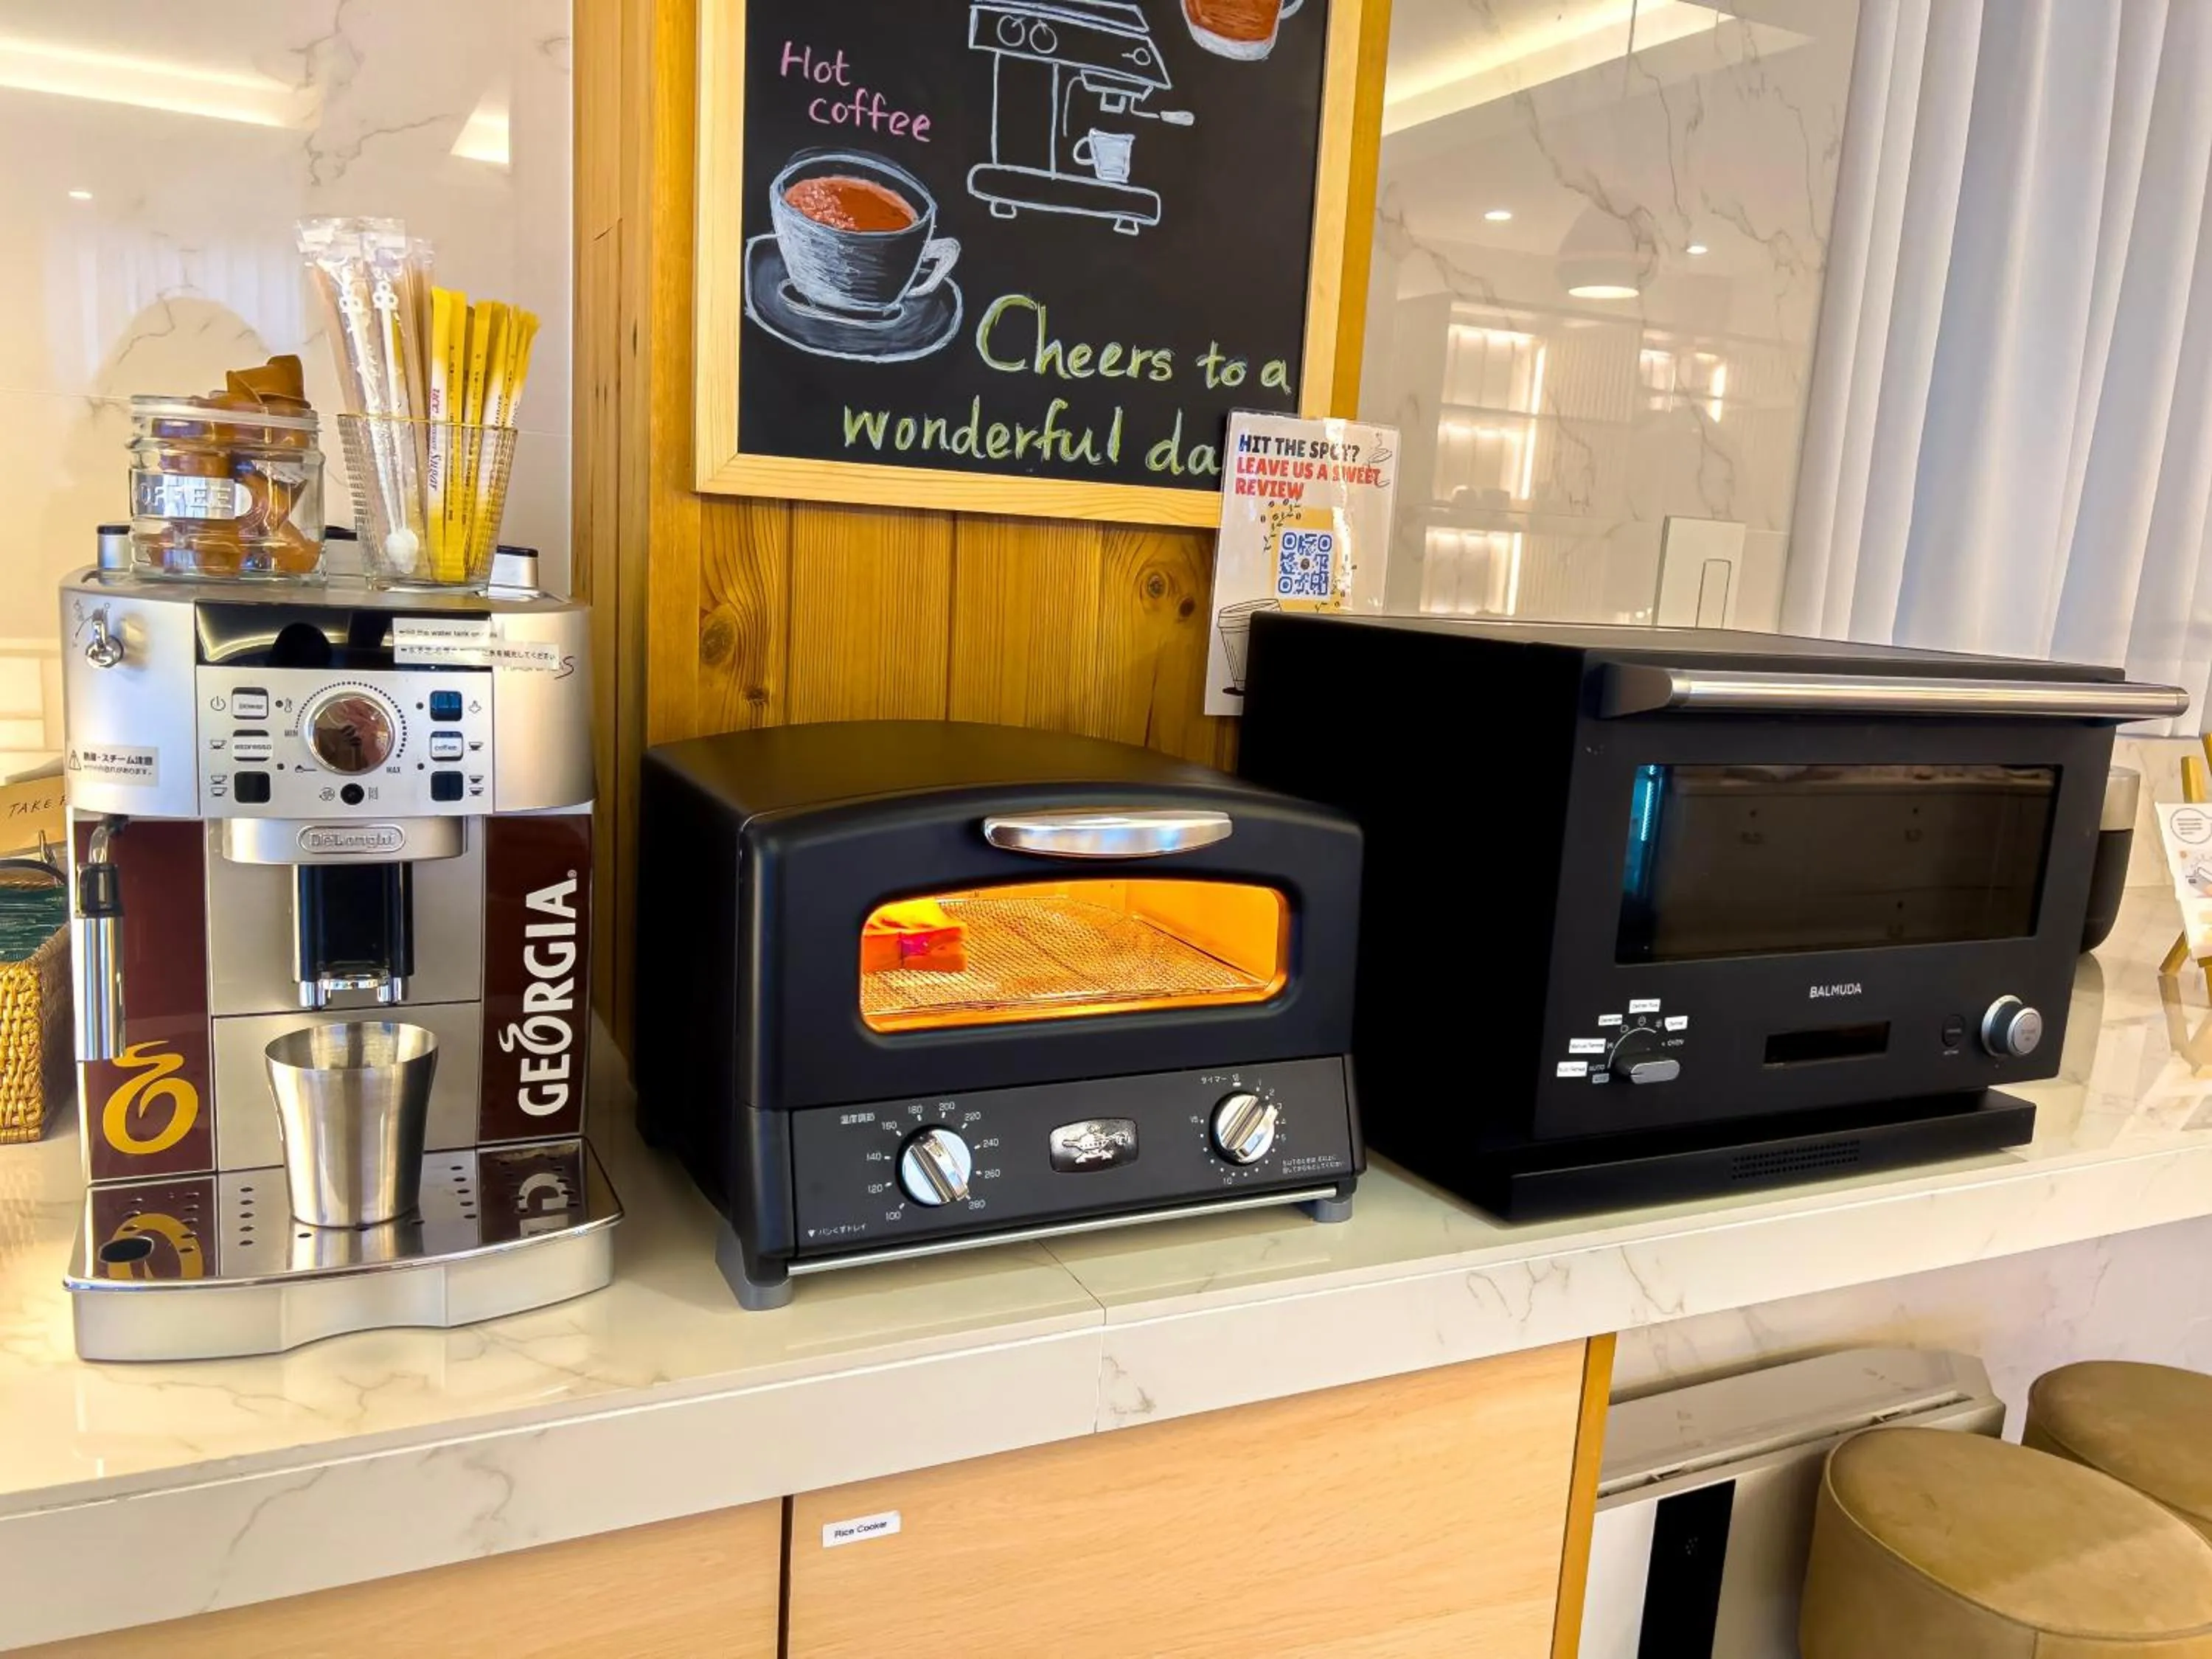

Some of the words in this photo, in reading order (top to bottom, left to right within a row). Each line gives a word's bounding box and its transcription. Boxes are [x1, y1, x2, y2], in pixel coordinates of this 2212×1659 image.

[780, 41, 851, 87] Hot
[808, 88, 933, 143] coffee
[975, 294, 1174, 381] Cheers
[1197, 341, 1248, 390] to
[1259, 358, 1293, 395] a
[842, 394, 1124, 466] wonderful
[1145, 408, 1222, 477] da
[1238, 434, 1271, 454] HIT
[1275, 438, 1306, 458] THE
[429, 454, 442, 491] Sugar
[1237, 456, 1289, 478] LEAVE
[1293, 462, 1313, 481] US
[1317, 464, 1327, 481] A
[1332, 467, 1381, 486] SWEET
[1235, 478, 1304, 500] REVIEW
[386, 766, 401, 774] MAX
[8, 799, 52, 818] TAKE
[498, 878, 578, 1117] GEORGIA
[1809, 982, 1862, 999] BALMUDA
[1200, 1075, 1228, 1085] タイマー
[908, 1105, 922, 1115] 180
[938, 1101, 956, 1111] 200
[964, 1110, 981, 1121] 220
[983, 1138, 1000, 1148] 240
[866, 1152, 882, 1162] 140
[984, 1169, 1001, 1179] 260
[1223, 1177, 1233, 1186] 10
[867, 1184, 884, 1194] 120
[885, 1211, 902, 1221] 100
[834, 1528, 855, 1539] Rice
[857, 1521, 888, 1533] Cooker
